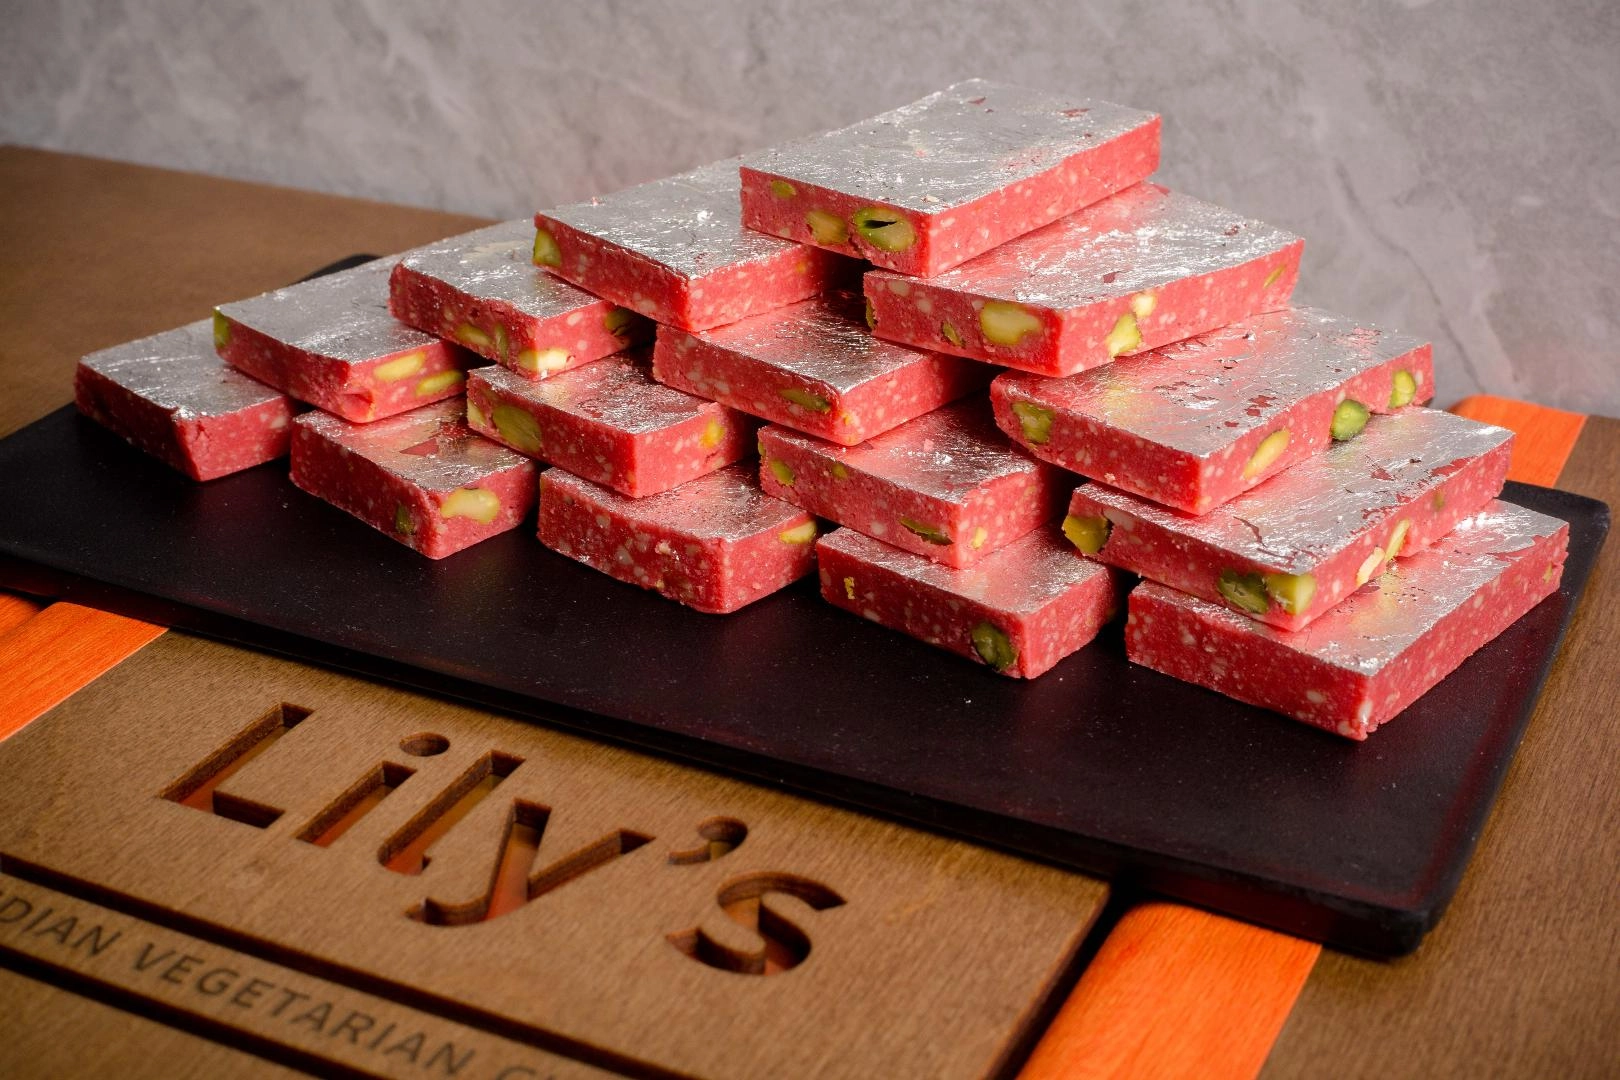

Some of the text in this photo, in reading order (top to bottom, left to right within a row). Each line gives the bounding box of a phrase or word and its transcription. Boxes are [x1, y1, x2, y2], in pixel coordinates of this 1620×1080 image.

[161, 703, 847, 975] Lily's
[0, 890, 475, 1075] DIAN VEGETARIAN
